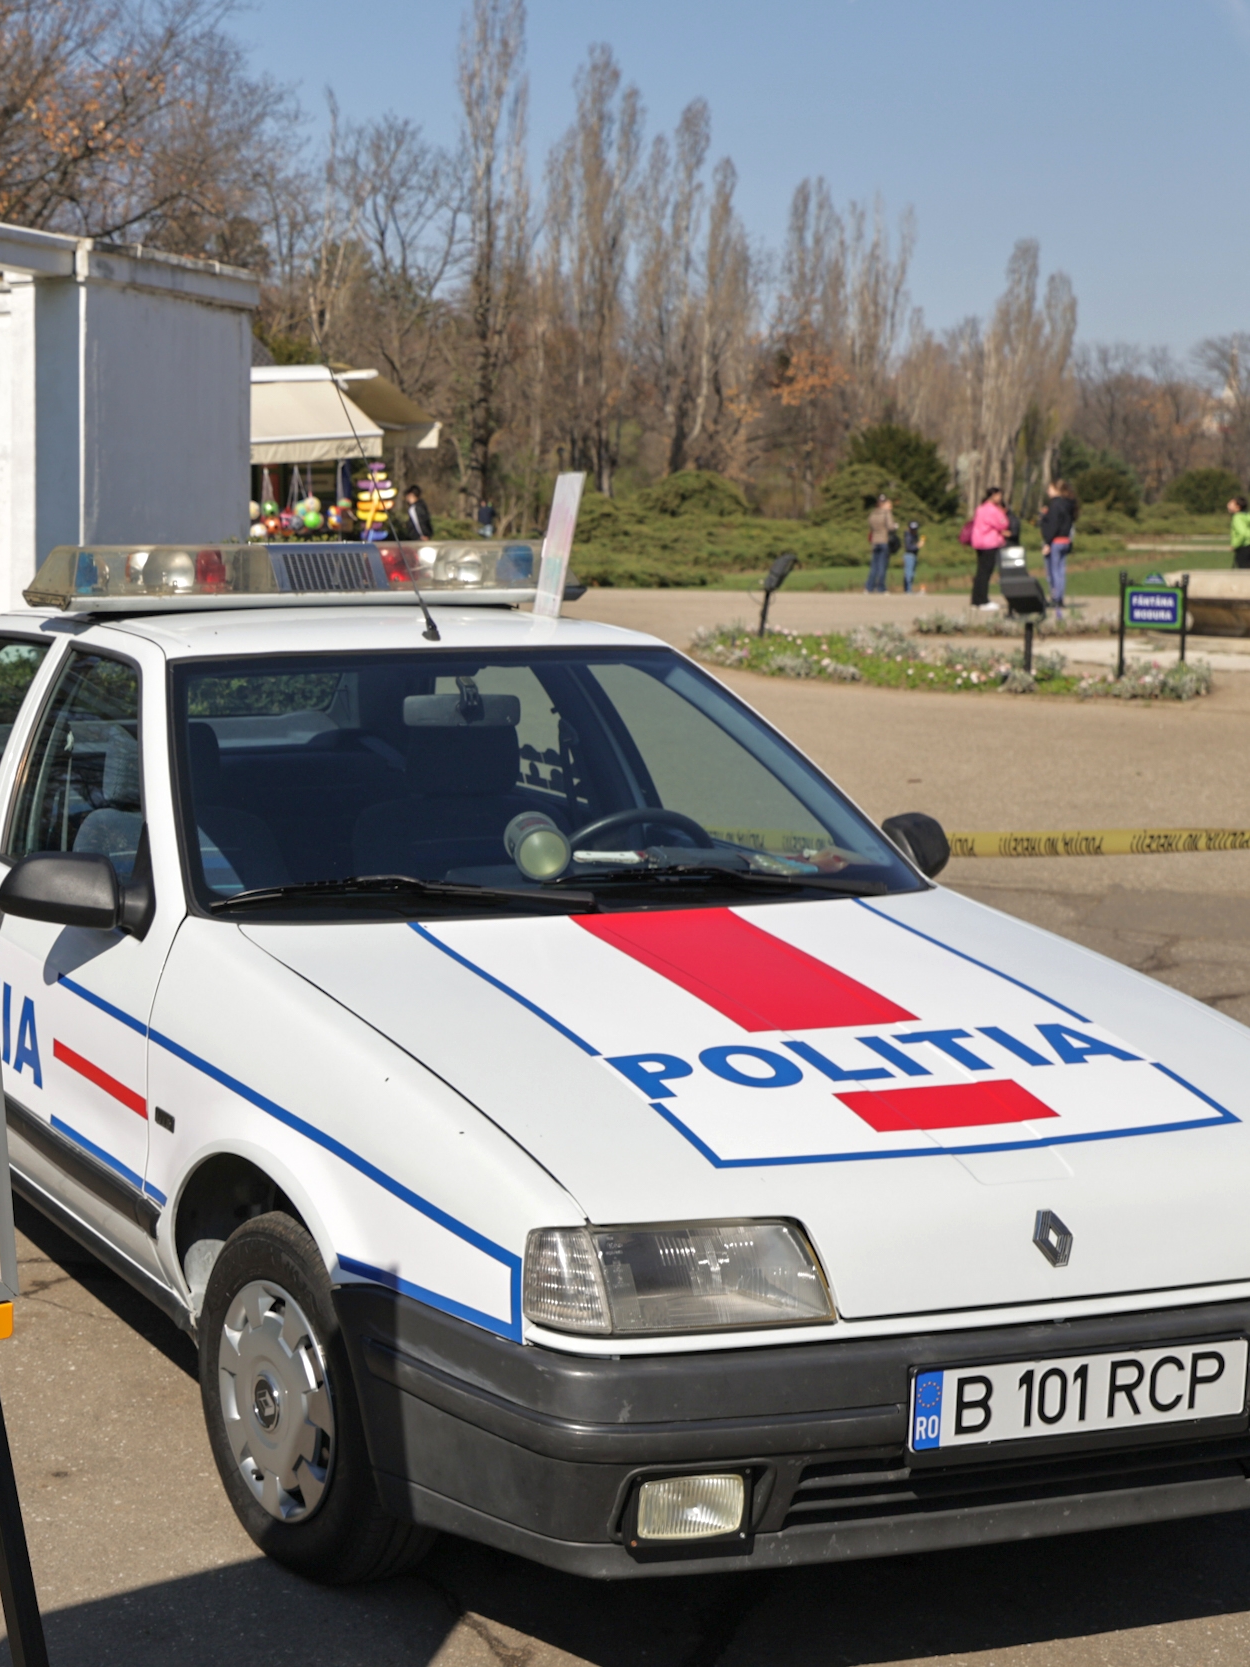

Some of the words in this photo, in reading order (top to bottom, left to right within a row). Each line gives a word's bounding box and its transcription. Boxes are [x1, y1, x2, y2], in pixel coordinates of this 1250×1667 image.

[602, 1023, 1147, 1100] POLITIA
[915, 1415, 939, 1441] RO
[954, 1375, 993, 1436] B
[1017, 1363, 1089, 1428] 101
[1106, 1350, 1226, 1418] RCP
